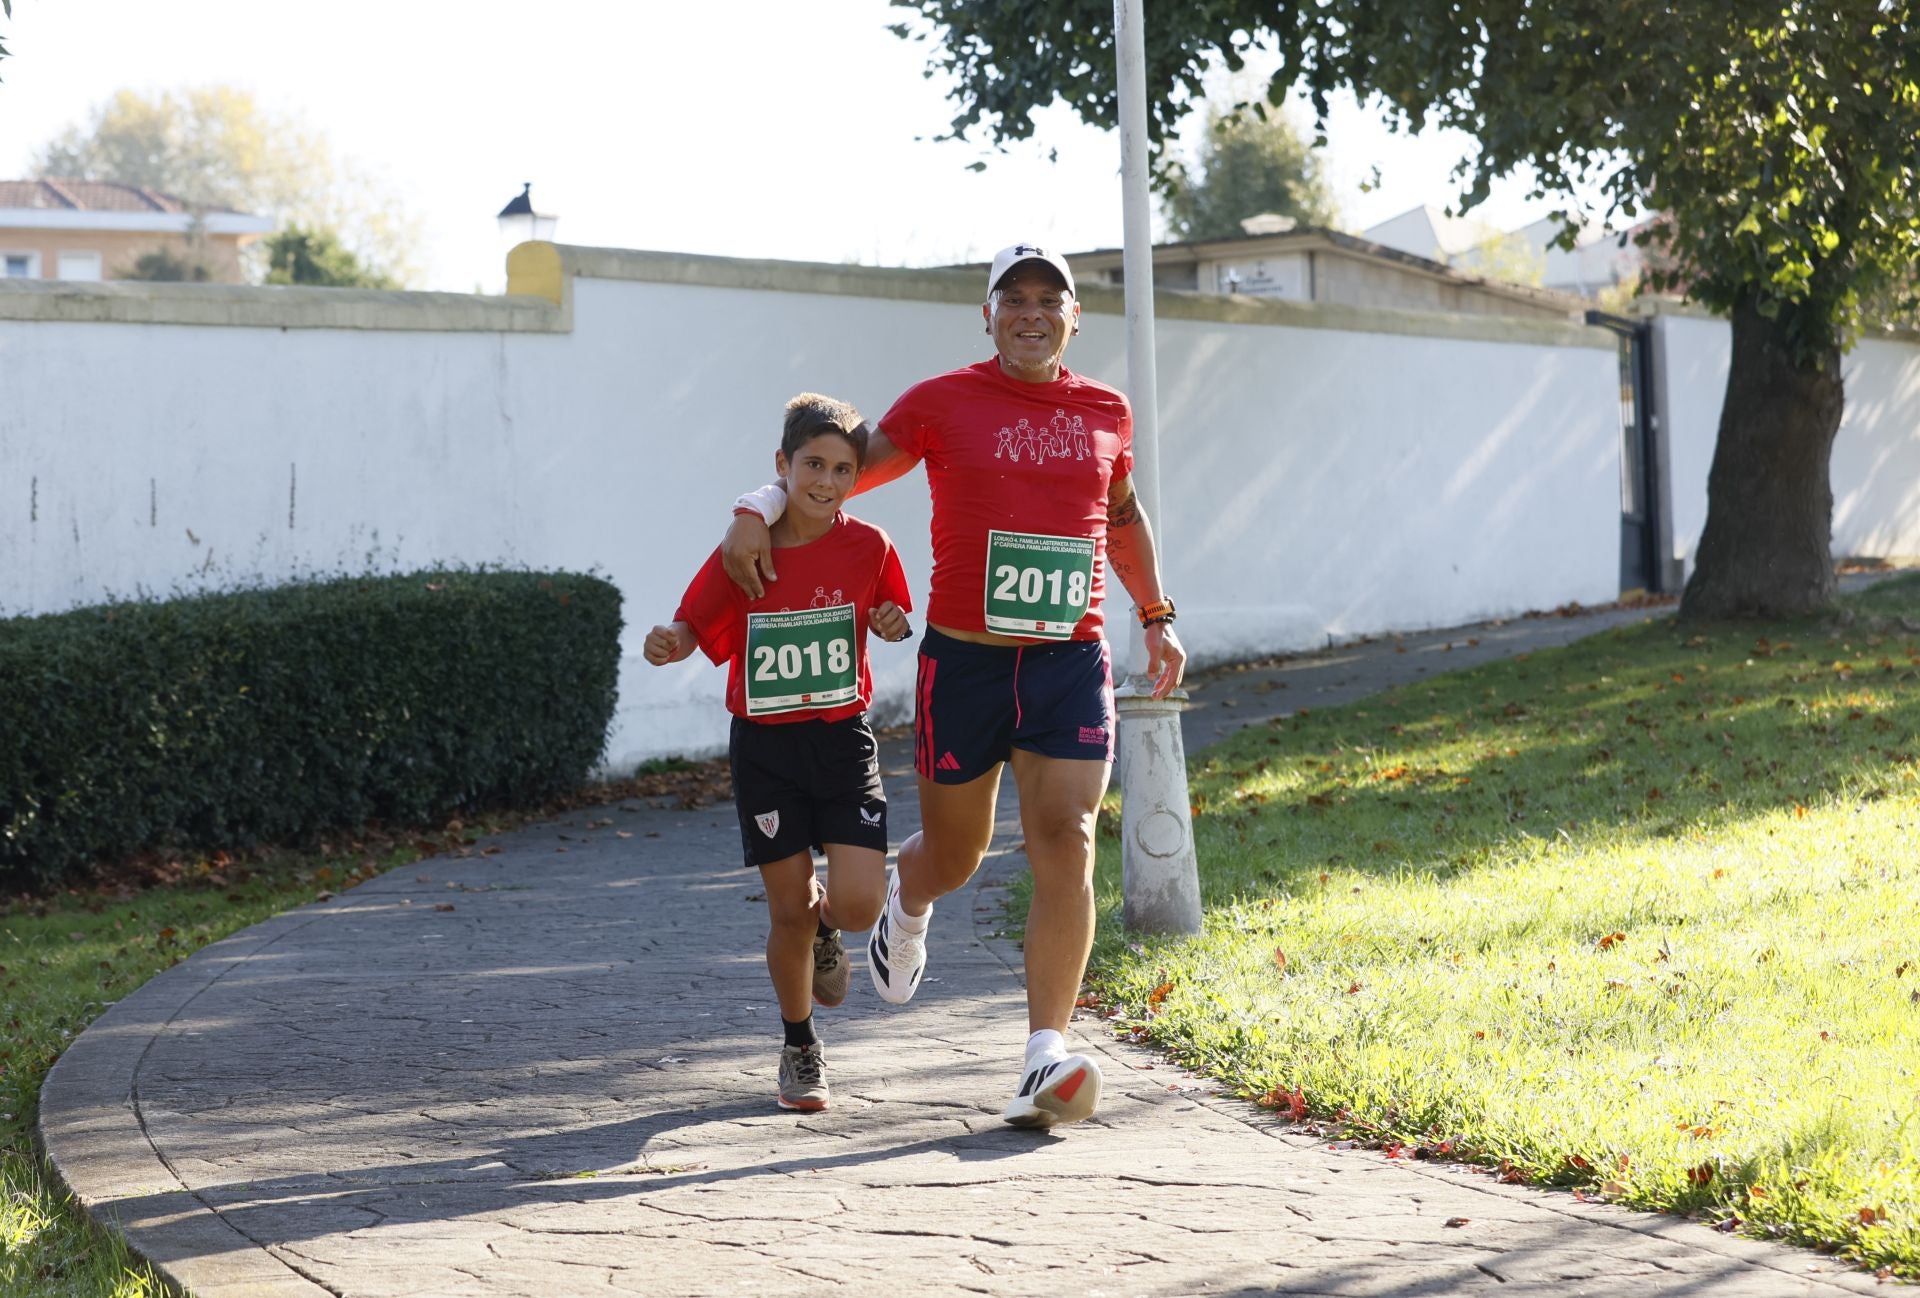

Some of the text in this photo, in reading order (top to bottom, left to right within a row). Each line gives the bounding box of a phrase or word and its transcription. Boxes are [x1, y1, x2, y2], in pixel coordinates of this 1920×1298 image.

[993, 565, 1086, 607] 2018
[778, 620, 802, 628] FAMILIAR
[803, 617, 832, 626] SOLIDARIA
[791, 613, 822, 622] LASTERKETA
[754, 638, 850, 681] 2018
